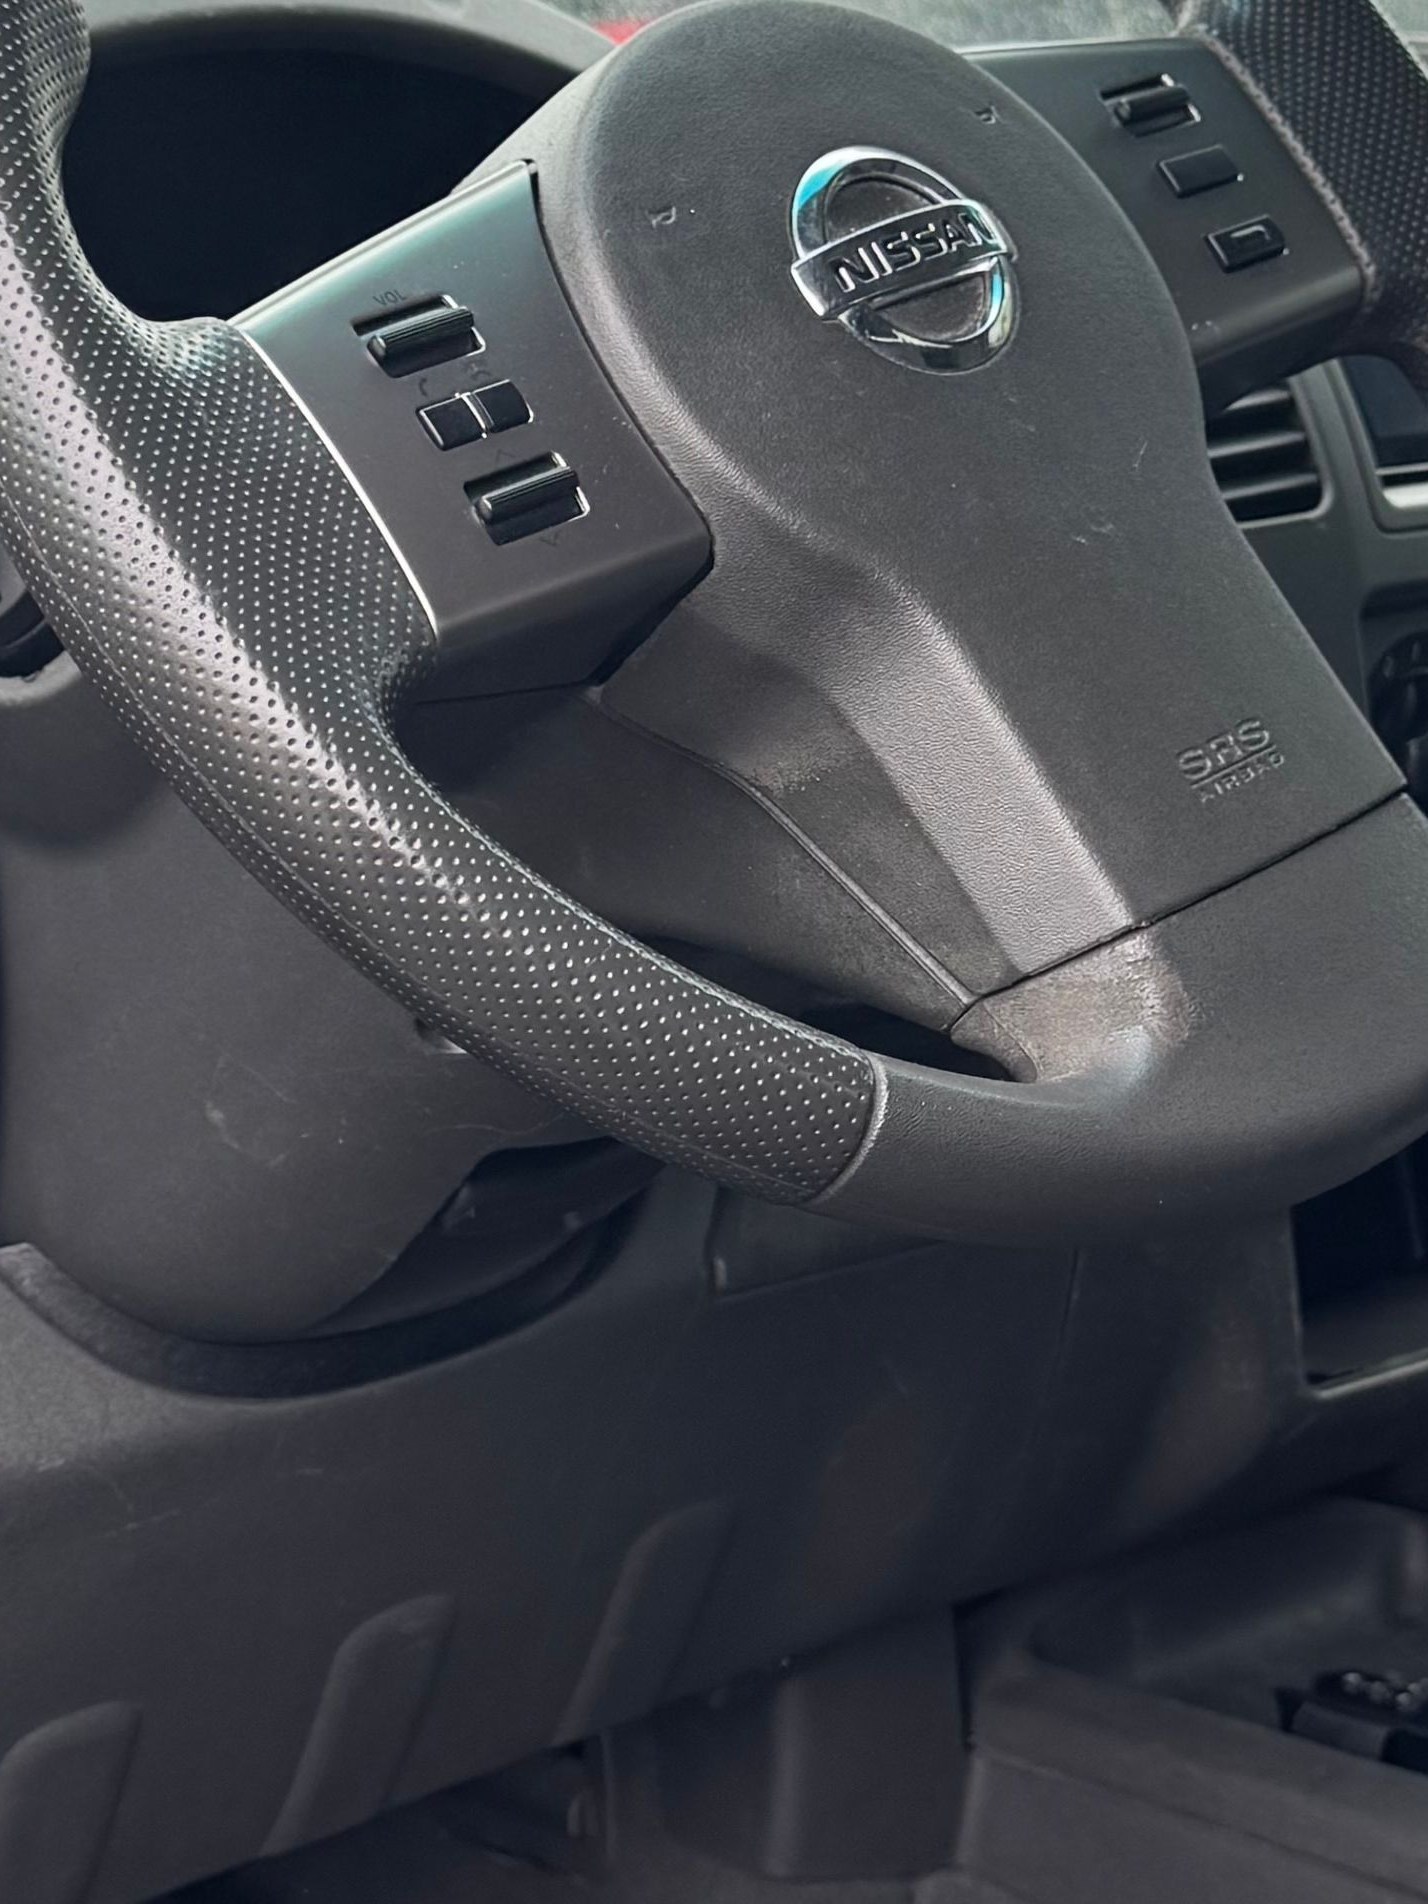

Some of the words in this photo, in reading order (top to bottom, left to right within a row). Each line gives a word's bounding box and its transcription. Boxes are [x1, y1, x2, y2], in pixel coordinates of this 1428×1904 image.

[829, 212, 998, 293] NISSAN
[372, 289, 408, 306] VOL
[1177, 717, 1270, 780] SRS
